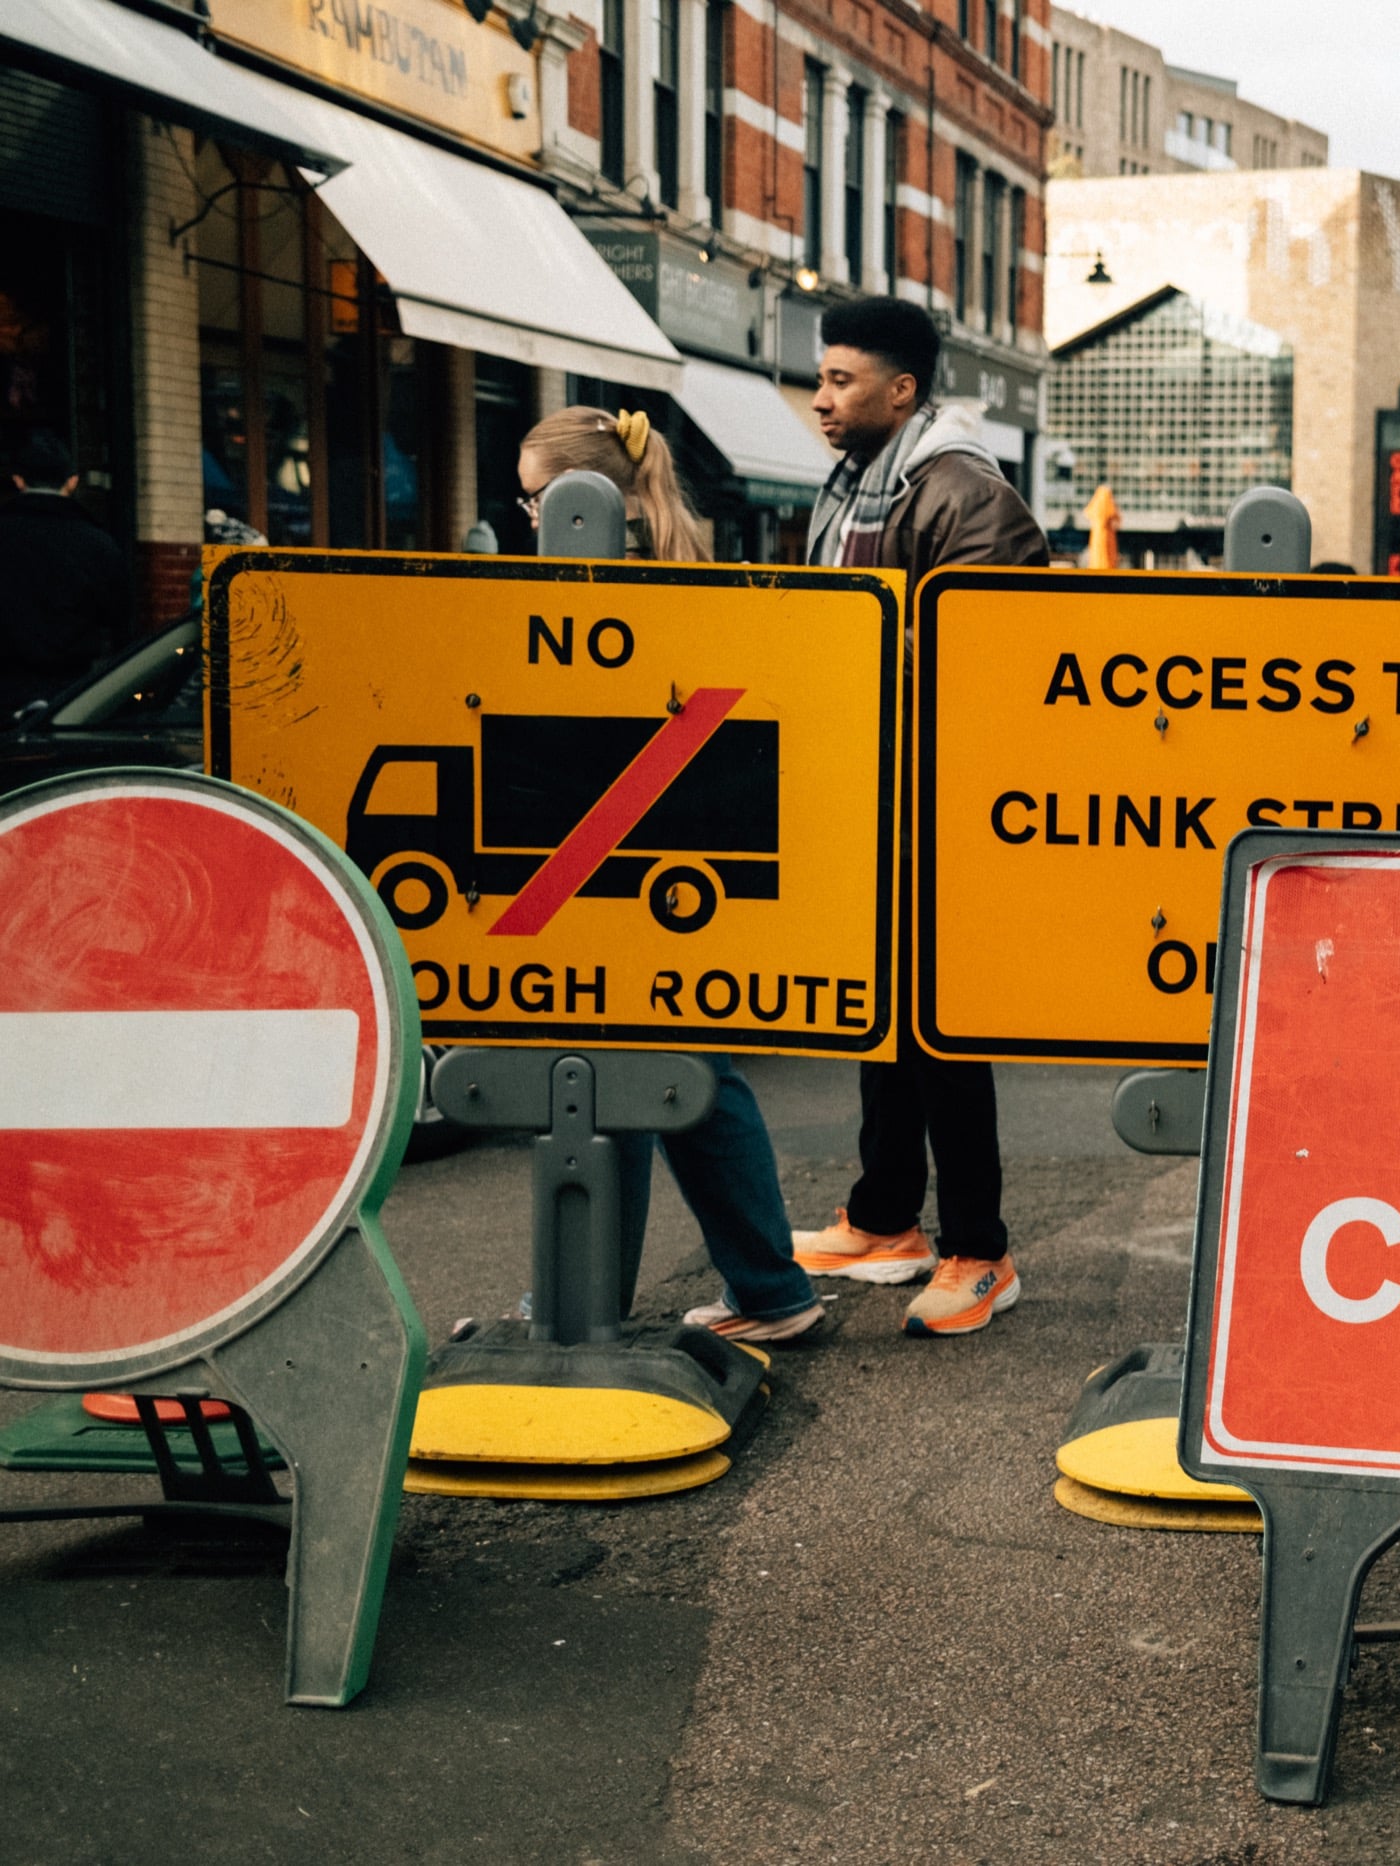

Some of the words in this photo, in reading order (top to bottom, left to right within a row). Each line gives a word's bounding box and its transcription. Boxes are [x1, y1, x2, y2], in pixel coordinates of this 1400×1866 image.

[308, 0, 467, 99] RAMBUTAN
[596, 243, 646, 263] RIGHT
[527, 614, 635, 669] NO
[1043, 652, 1356, 715] ACCESS
[990, 790, 1217, 850] CLINK
[415, 959, 607, 1015] OUGH
[650, 969, 868, 1029] ROUTE
[970, 1269, 998, 1300] HOKA
